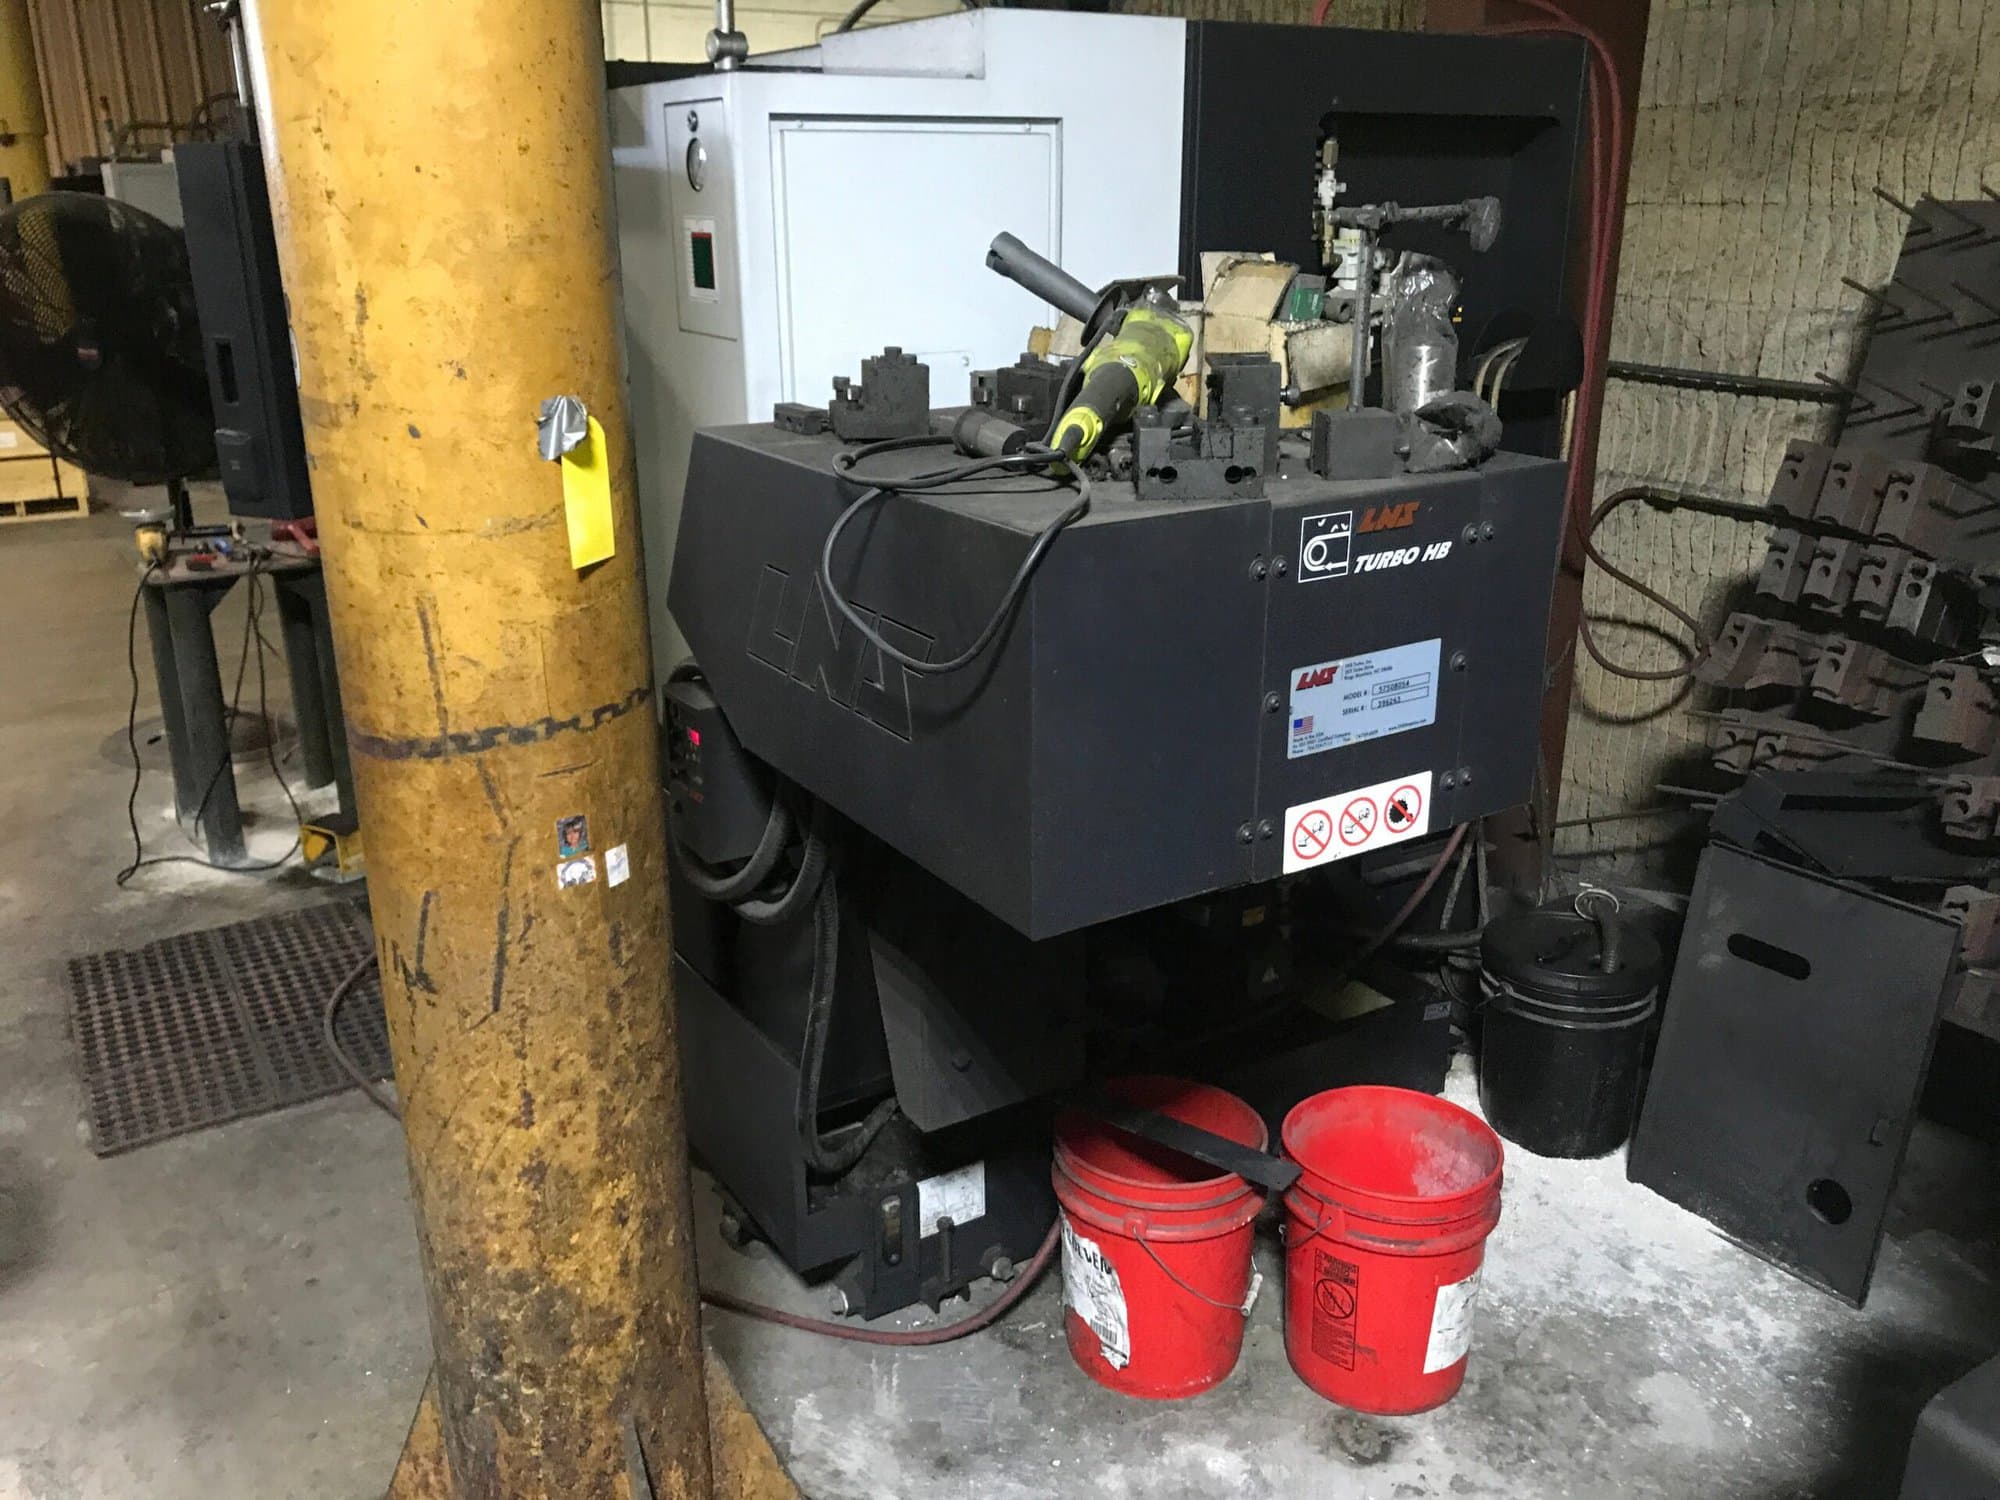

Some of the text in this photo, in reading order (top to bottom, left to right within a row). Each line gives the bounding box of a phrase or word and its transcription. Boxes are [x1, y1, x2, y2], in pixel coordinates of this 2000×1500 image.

[1358, 502, 1420, 533] LNS
[1354, 541, 1453, 574] TURBO HB
[1296, 666, 1339, 691] LNS
[1343, 691, 1362, 700] MODEL
[1342, 706, 1360, 716] SERIAL
